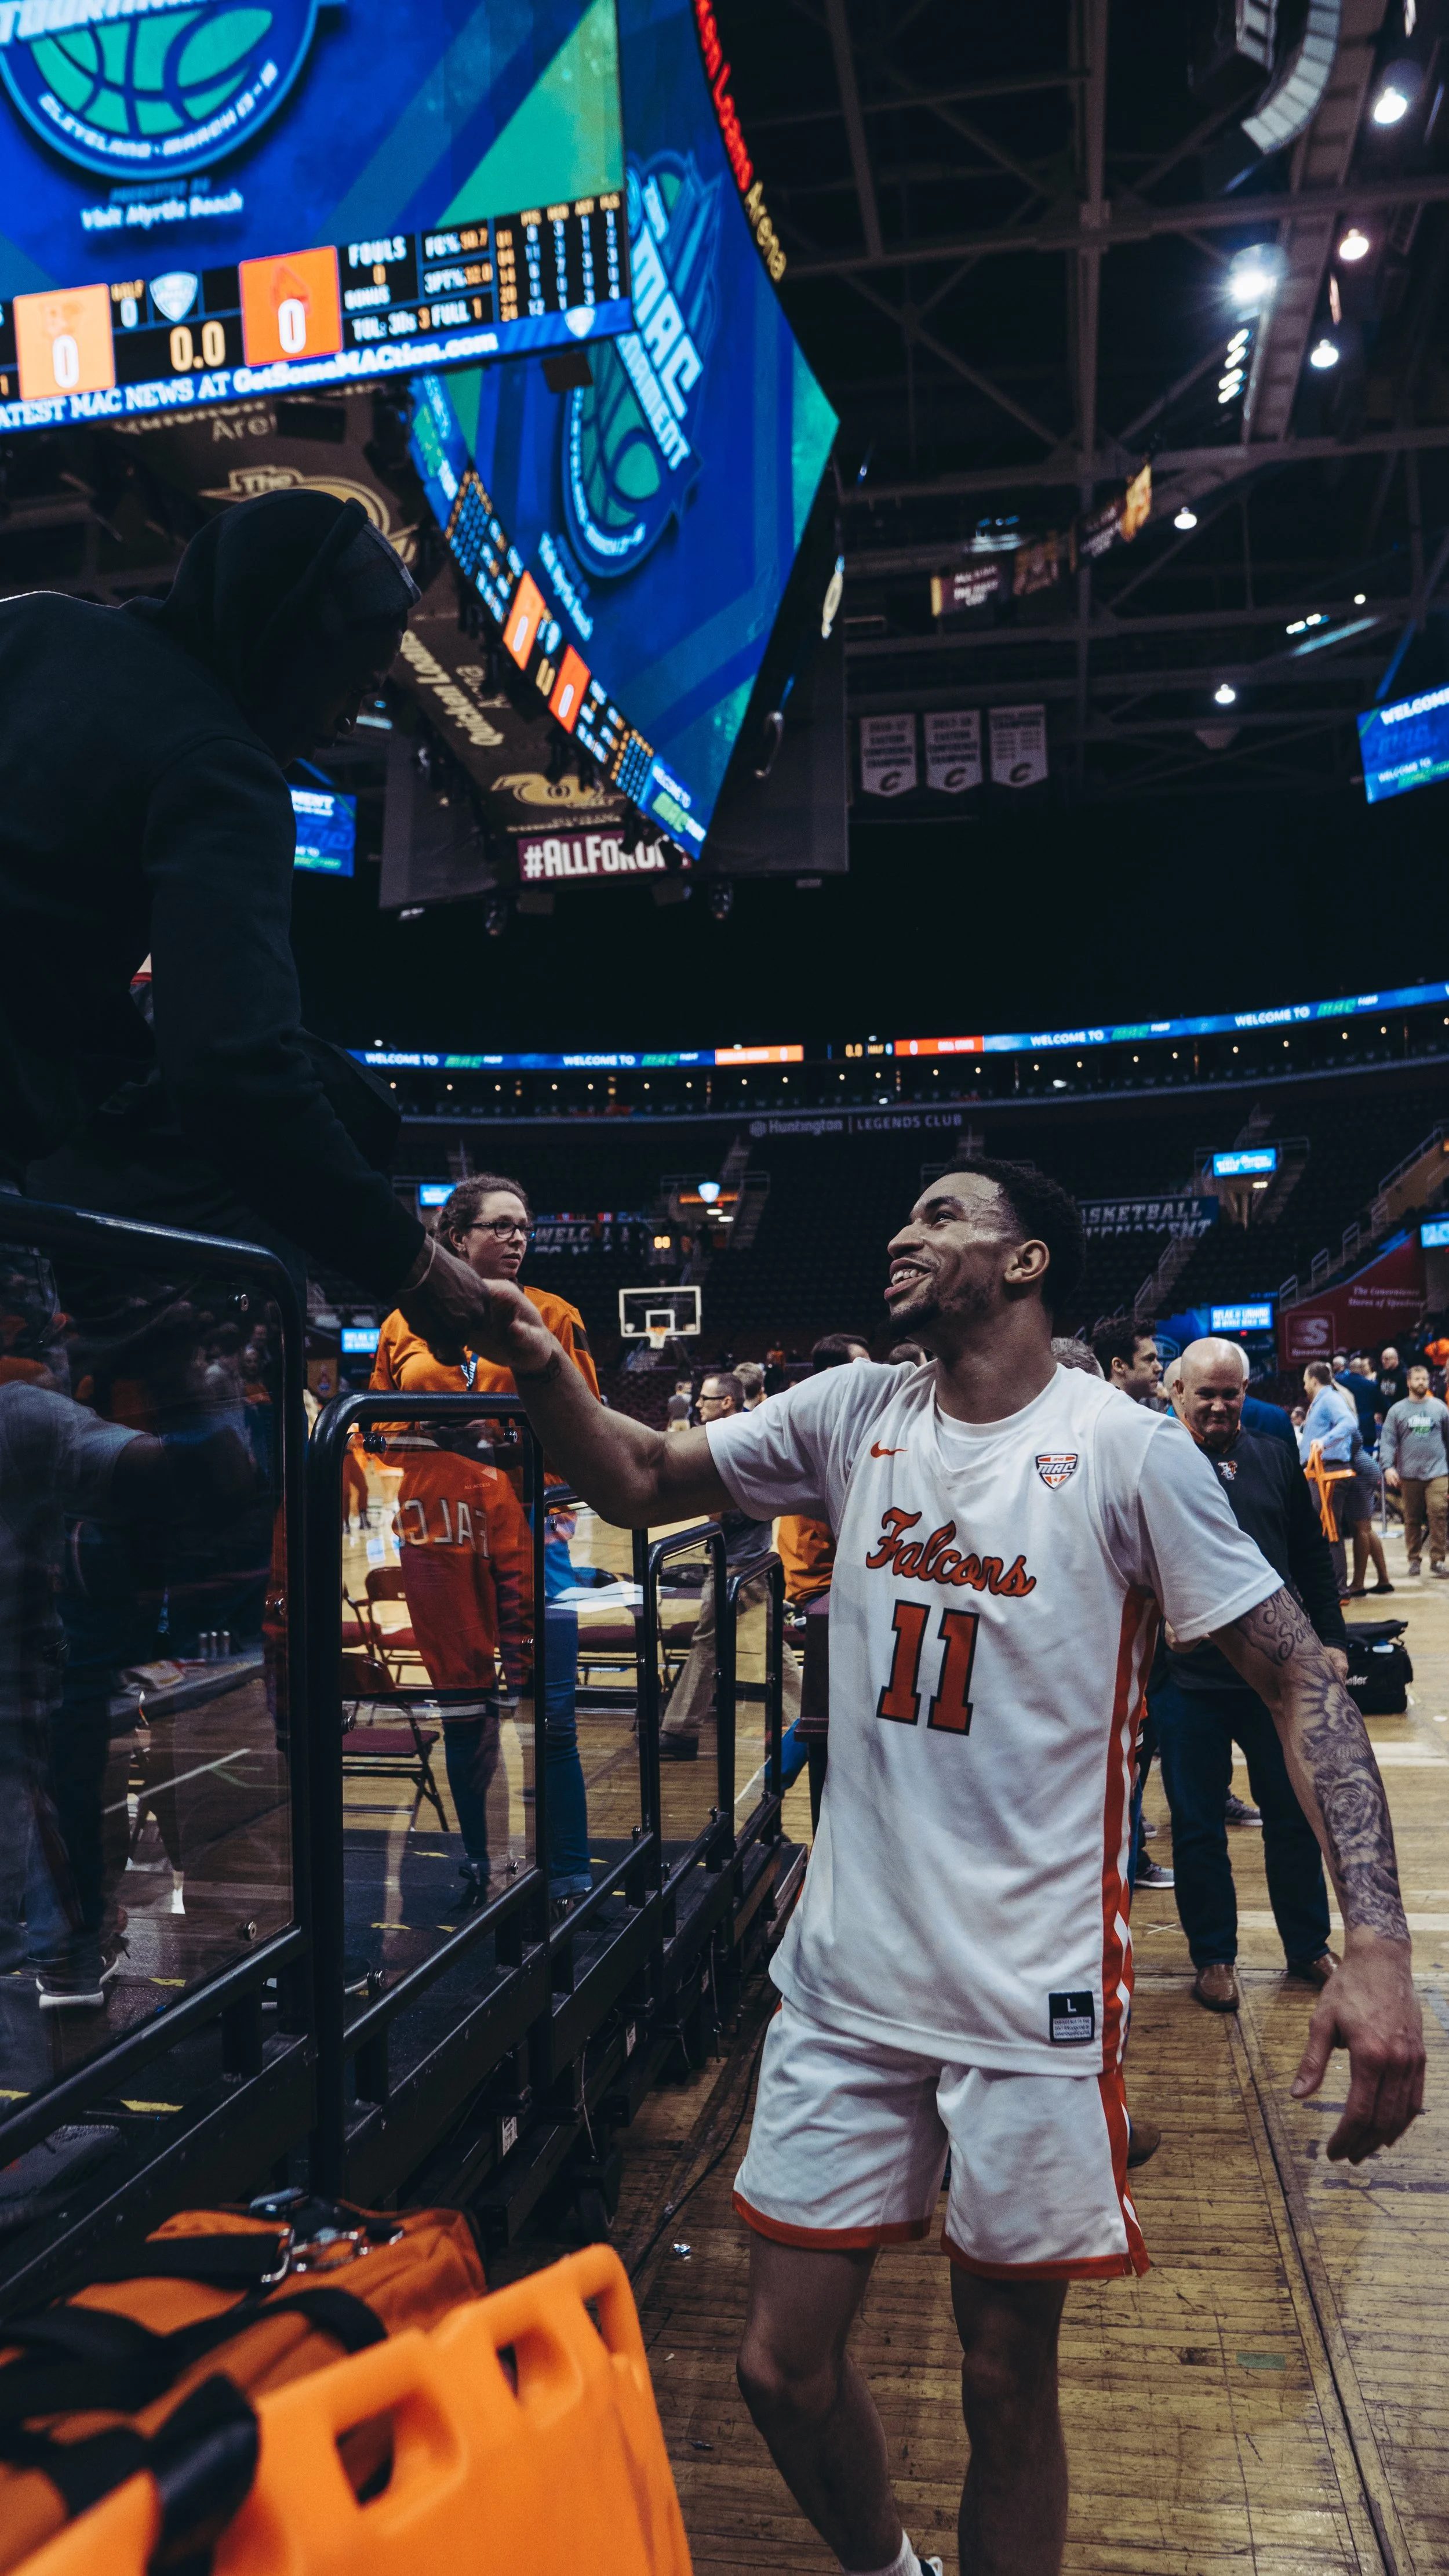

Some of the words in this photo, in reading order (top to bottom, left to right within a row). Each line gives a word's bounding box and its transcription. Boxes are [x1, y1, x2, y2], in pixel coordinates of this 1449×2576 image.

[348, 235, 407, 268] FOULS
[278, 299, 306, 354] 0
[431, 300, 471, 328] FULL
[170, 321, 226, 372] 0.0
[52, 335, 79, 388] 0
[71, 388, 122, 419] MAC
[126, 377, 194, 410] NEWS
[198, 371, 230, 399] AT
[1234, 1008, 1292, 1027] WELCOME
[1293, 1005, 1310, 1019] TO
[1031, 1031, 1086, 1046] WELCOME
[1087, 1029, 1104, 1042] TO
[365, 1052, 421, 1066] WELCOME
[423, 1054, 439, 1066] TO
[562, 1055, 617, 1066] WELCOME
[618, 1055, 636, 1066] TO
[768, 1118, 843, 1136] Huntington
[857, 1115, 921, 1131] LEGENDS
[924, 1113, 963, 1128] CLUB
[1037, 1462, 1075, 1474] MAC
[866, 1507, 1037, 1597] Falcons
[876, 1599, 980, 1735] 11
[1066, 1998, 1077, 2012] L
